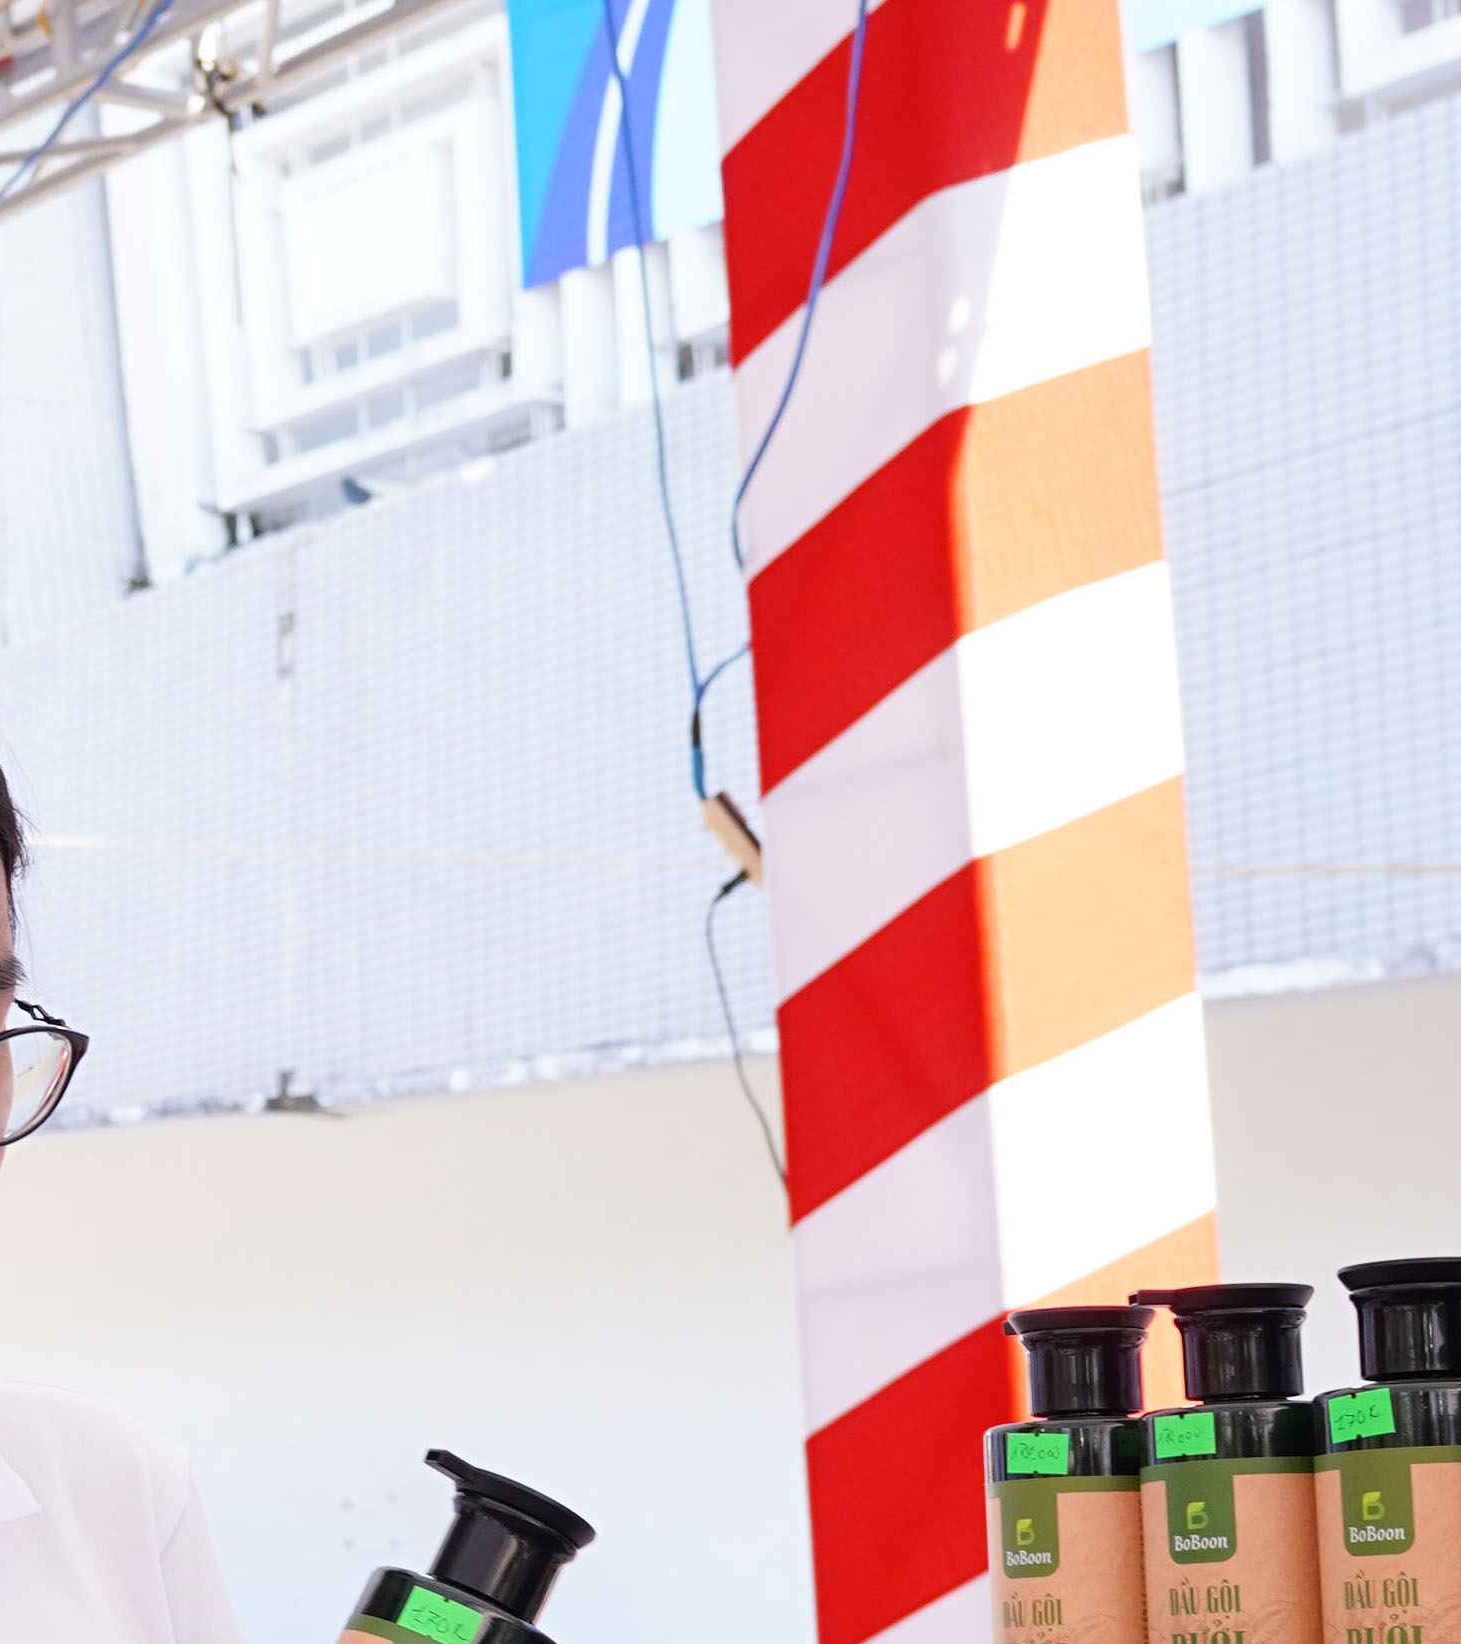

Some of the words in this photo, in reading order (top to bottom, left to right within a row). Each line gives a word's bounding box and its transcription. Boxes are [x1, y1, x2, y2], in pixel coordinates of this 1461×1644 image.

[1174, 1534, 1228, 1552] BoBoon
[1349, 1525, 1406, 1543] BoBoon
[1006, 1551, 1052, 1566] BoBoon
[1169, 1577, 1199, 1616] DẦU
[1206, 1579, 1241, 1619] GỘI
[1343, 1569, 1374, 1610] DẦU
[1382, 1571, 1421, 1614] GỘI
[1032, 1594, 1063, 1633] GỘI
